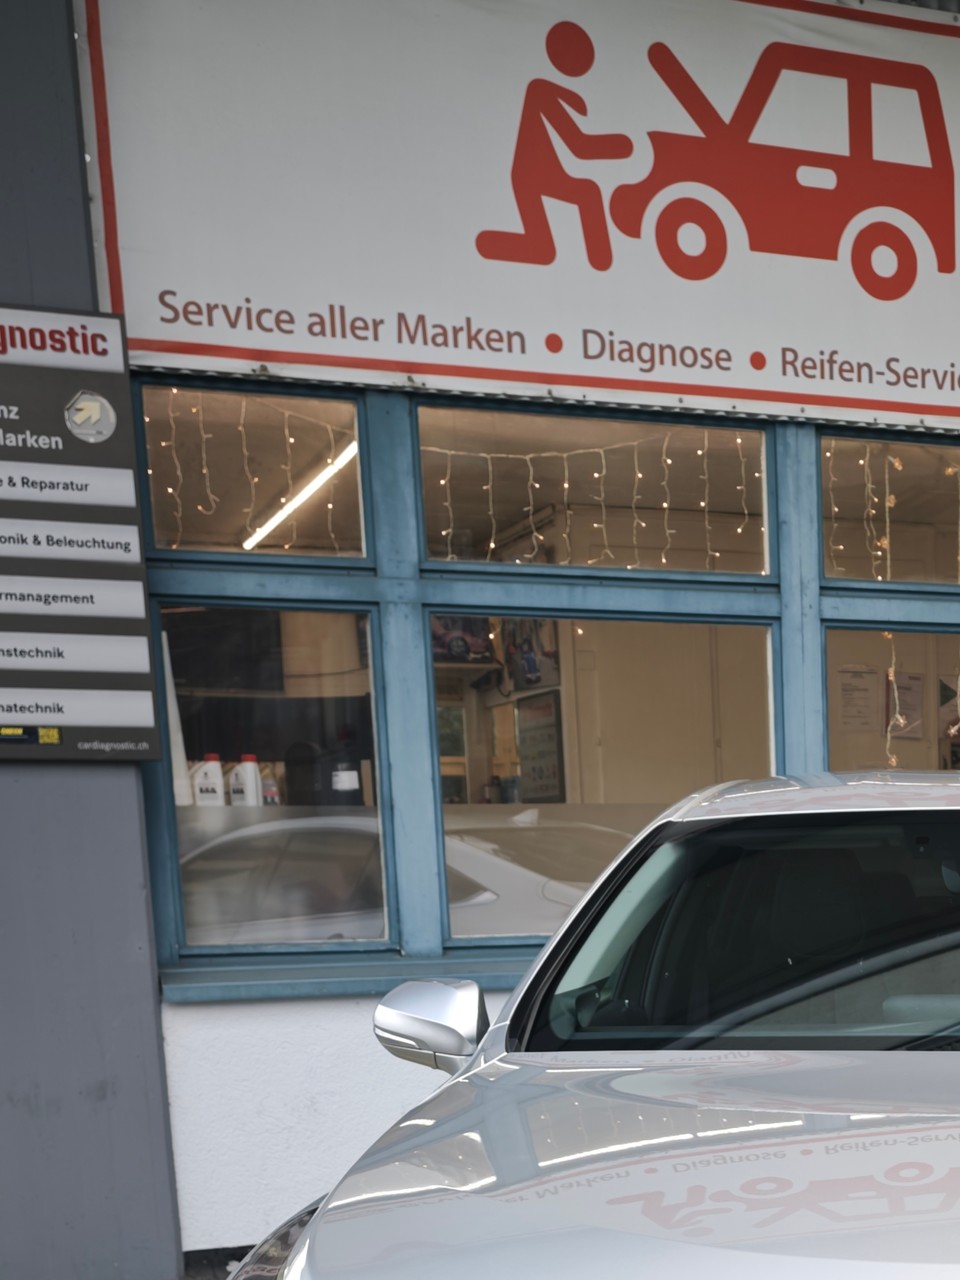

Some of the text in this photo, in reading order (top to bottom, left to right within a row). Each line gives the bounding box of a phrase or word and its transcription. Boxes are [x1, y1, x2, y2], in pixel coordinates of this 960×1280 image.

[157, 289, 296, 335] Service
[306, 305, 385, 344] aller
[396, 312, 527, 354] Marken
[580, 329, 733, 373] Diagnose
[0, 427, 63, 450] arken
[7, 475, 17, 488] &
[20, 476, 90, 493] Reparatur
[32, 534, 42, 547] &
[46, 534, 132, 554] Beleuchtung
[77, 741, 150, 753] cardiagnostic.ch
